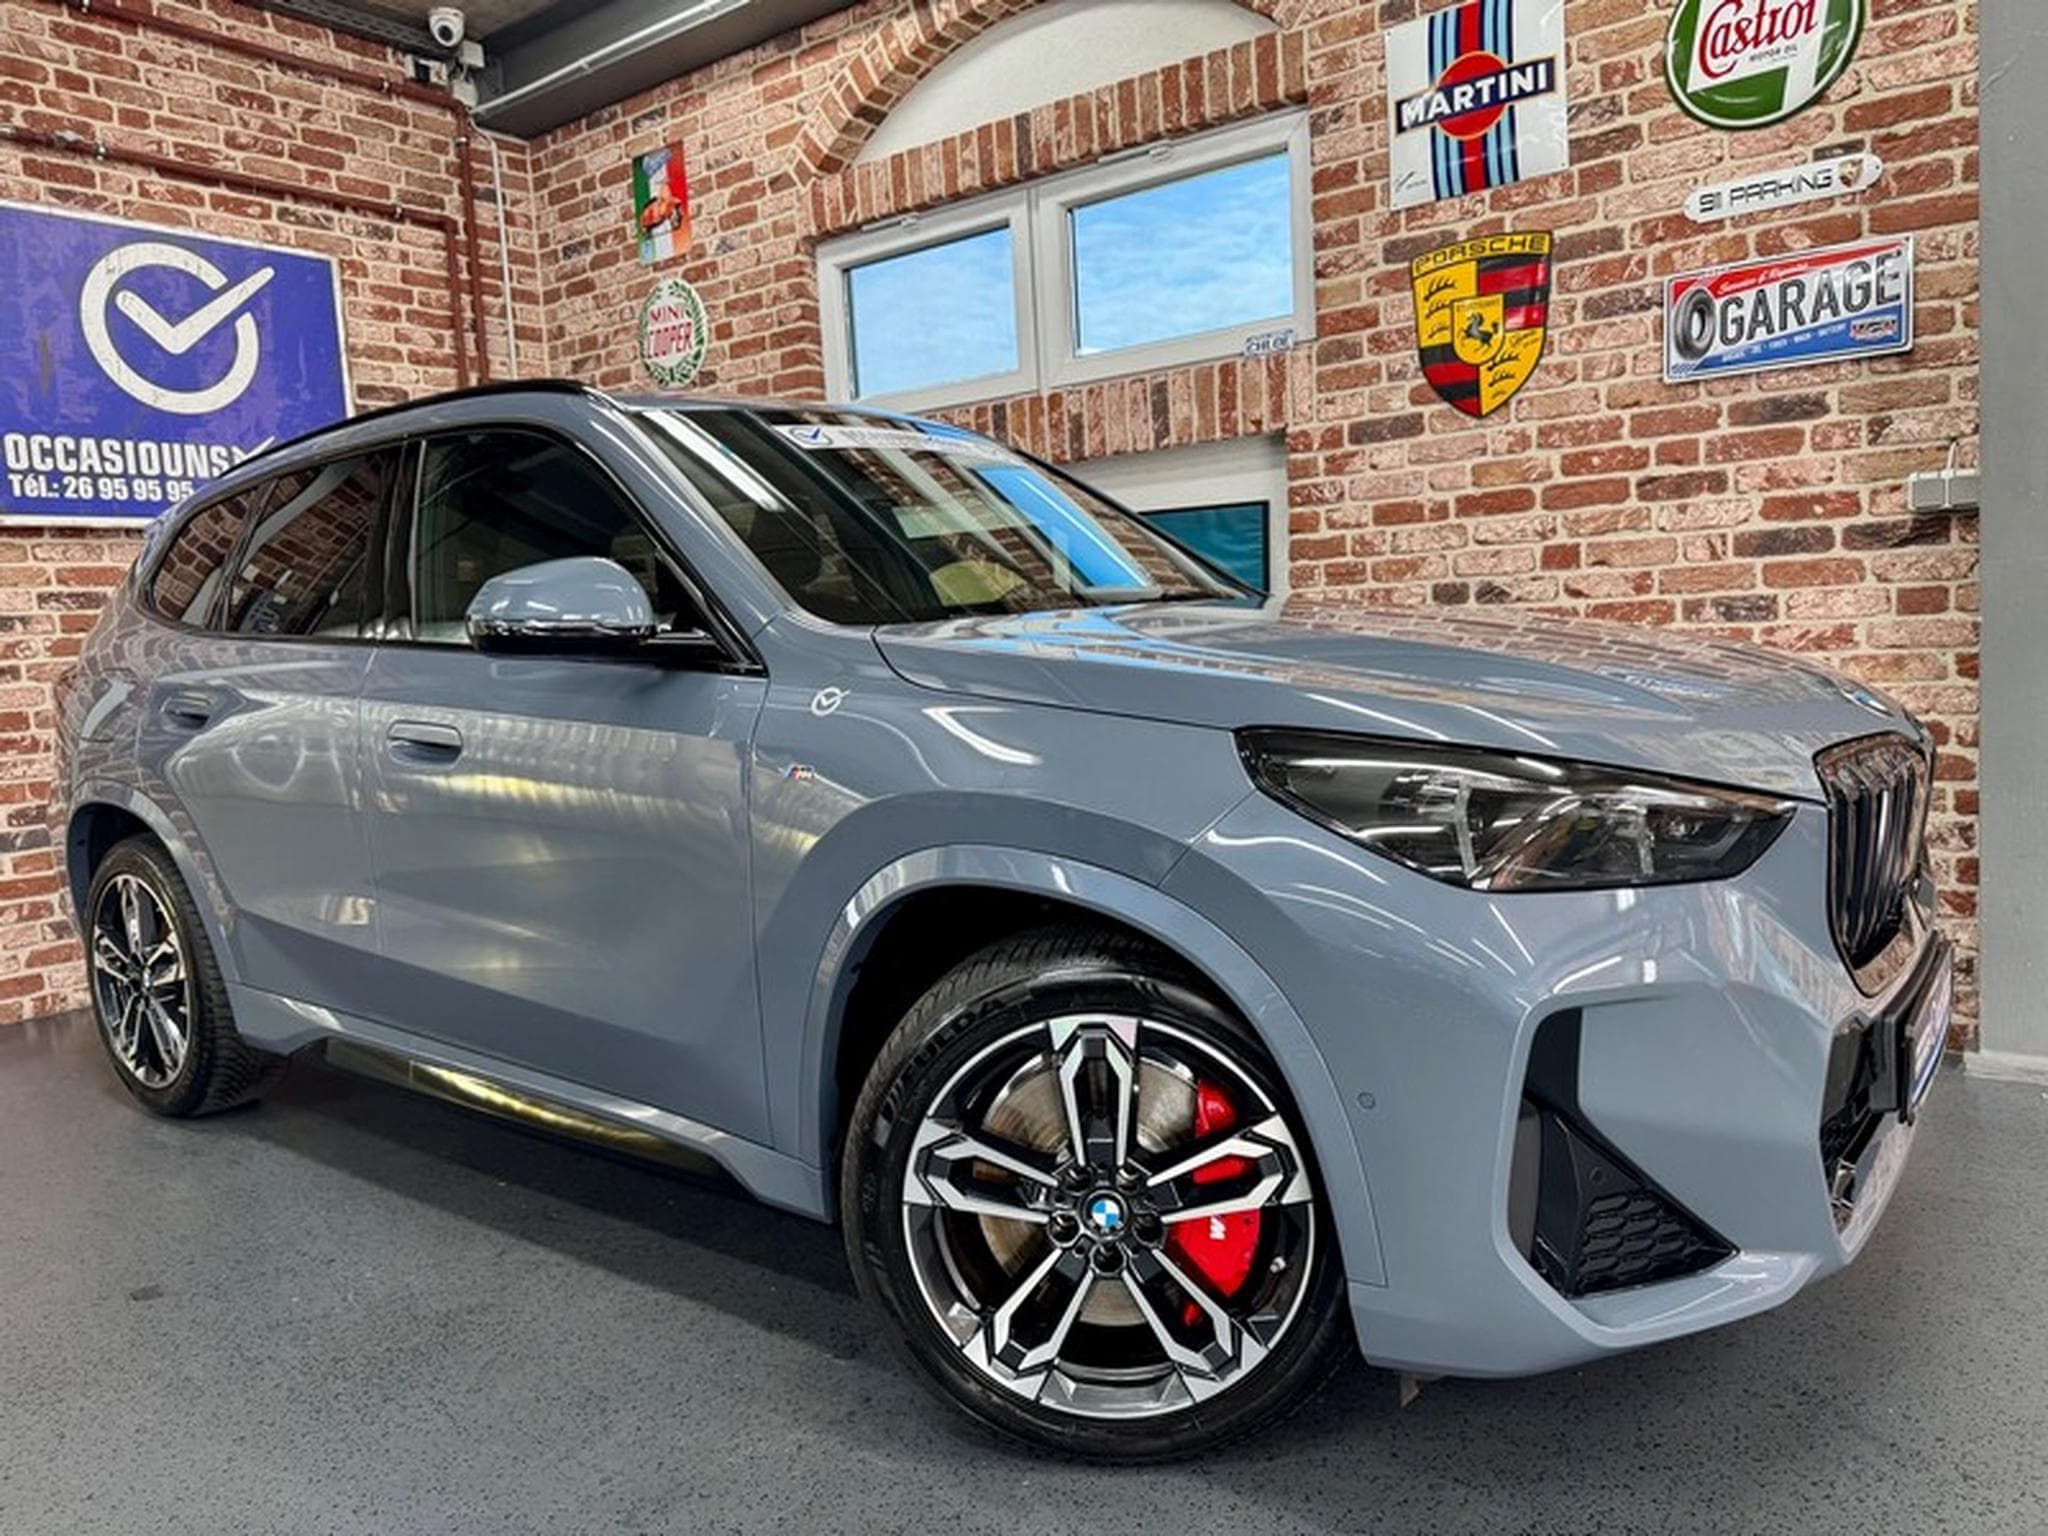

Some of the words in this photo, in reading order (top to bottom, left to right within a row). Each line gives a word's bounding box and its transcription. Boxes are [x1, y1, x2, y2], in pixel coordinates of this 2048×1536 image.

[1401, 63, 1548, 128] MARTINI
[1415, 235, 1546, 274] PORSCHE
[1719, 250, 1903, 346] GARAGE
[4, 432, 230, 478] OCCASIOUNS
[63, 475, 95, 500] 26
[98, 477, 130, 501] 95
[132, 478, 163, 502] 95
[166, 480, 196, 503] 95
